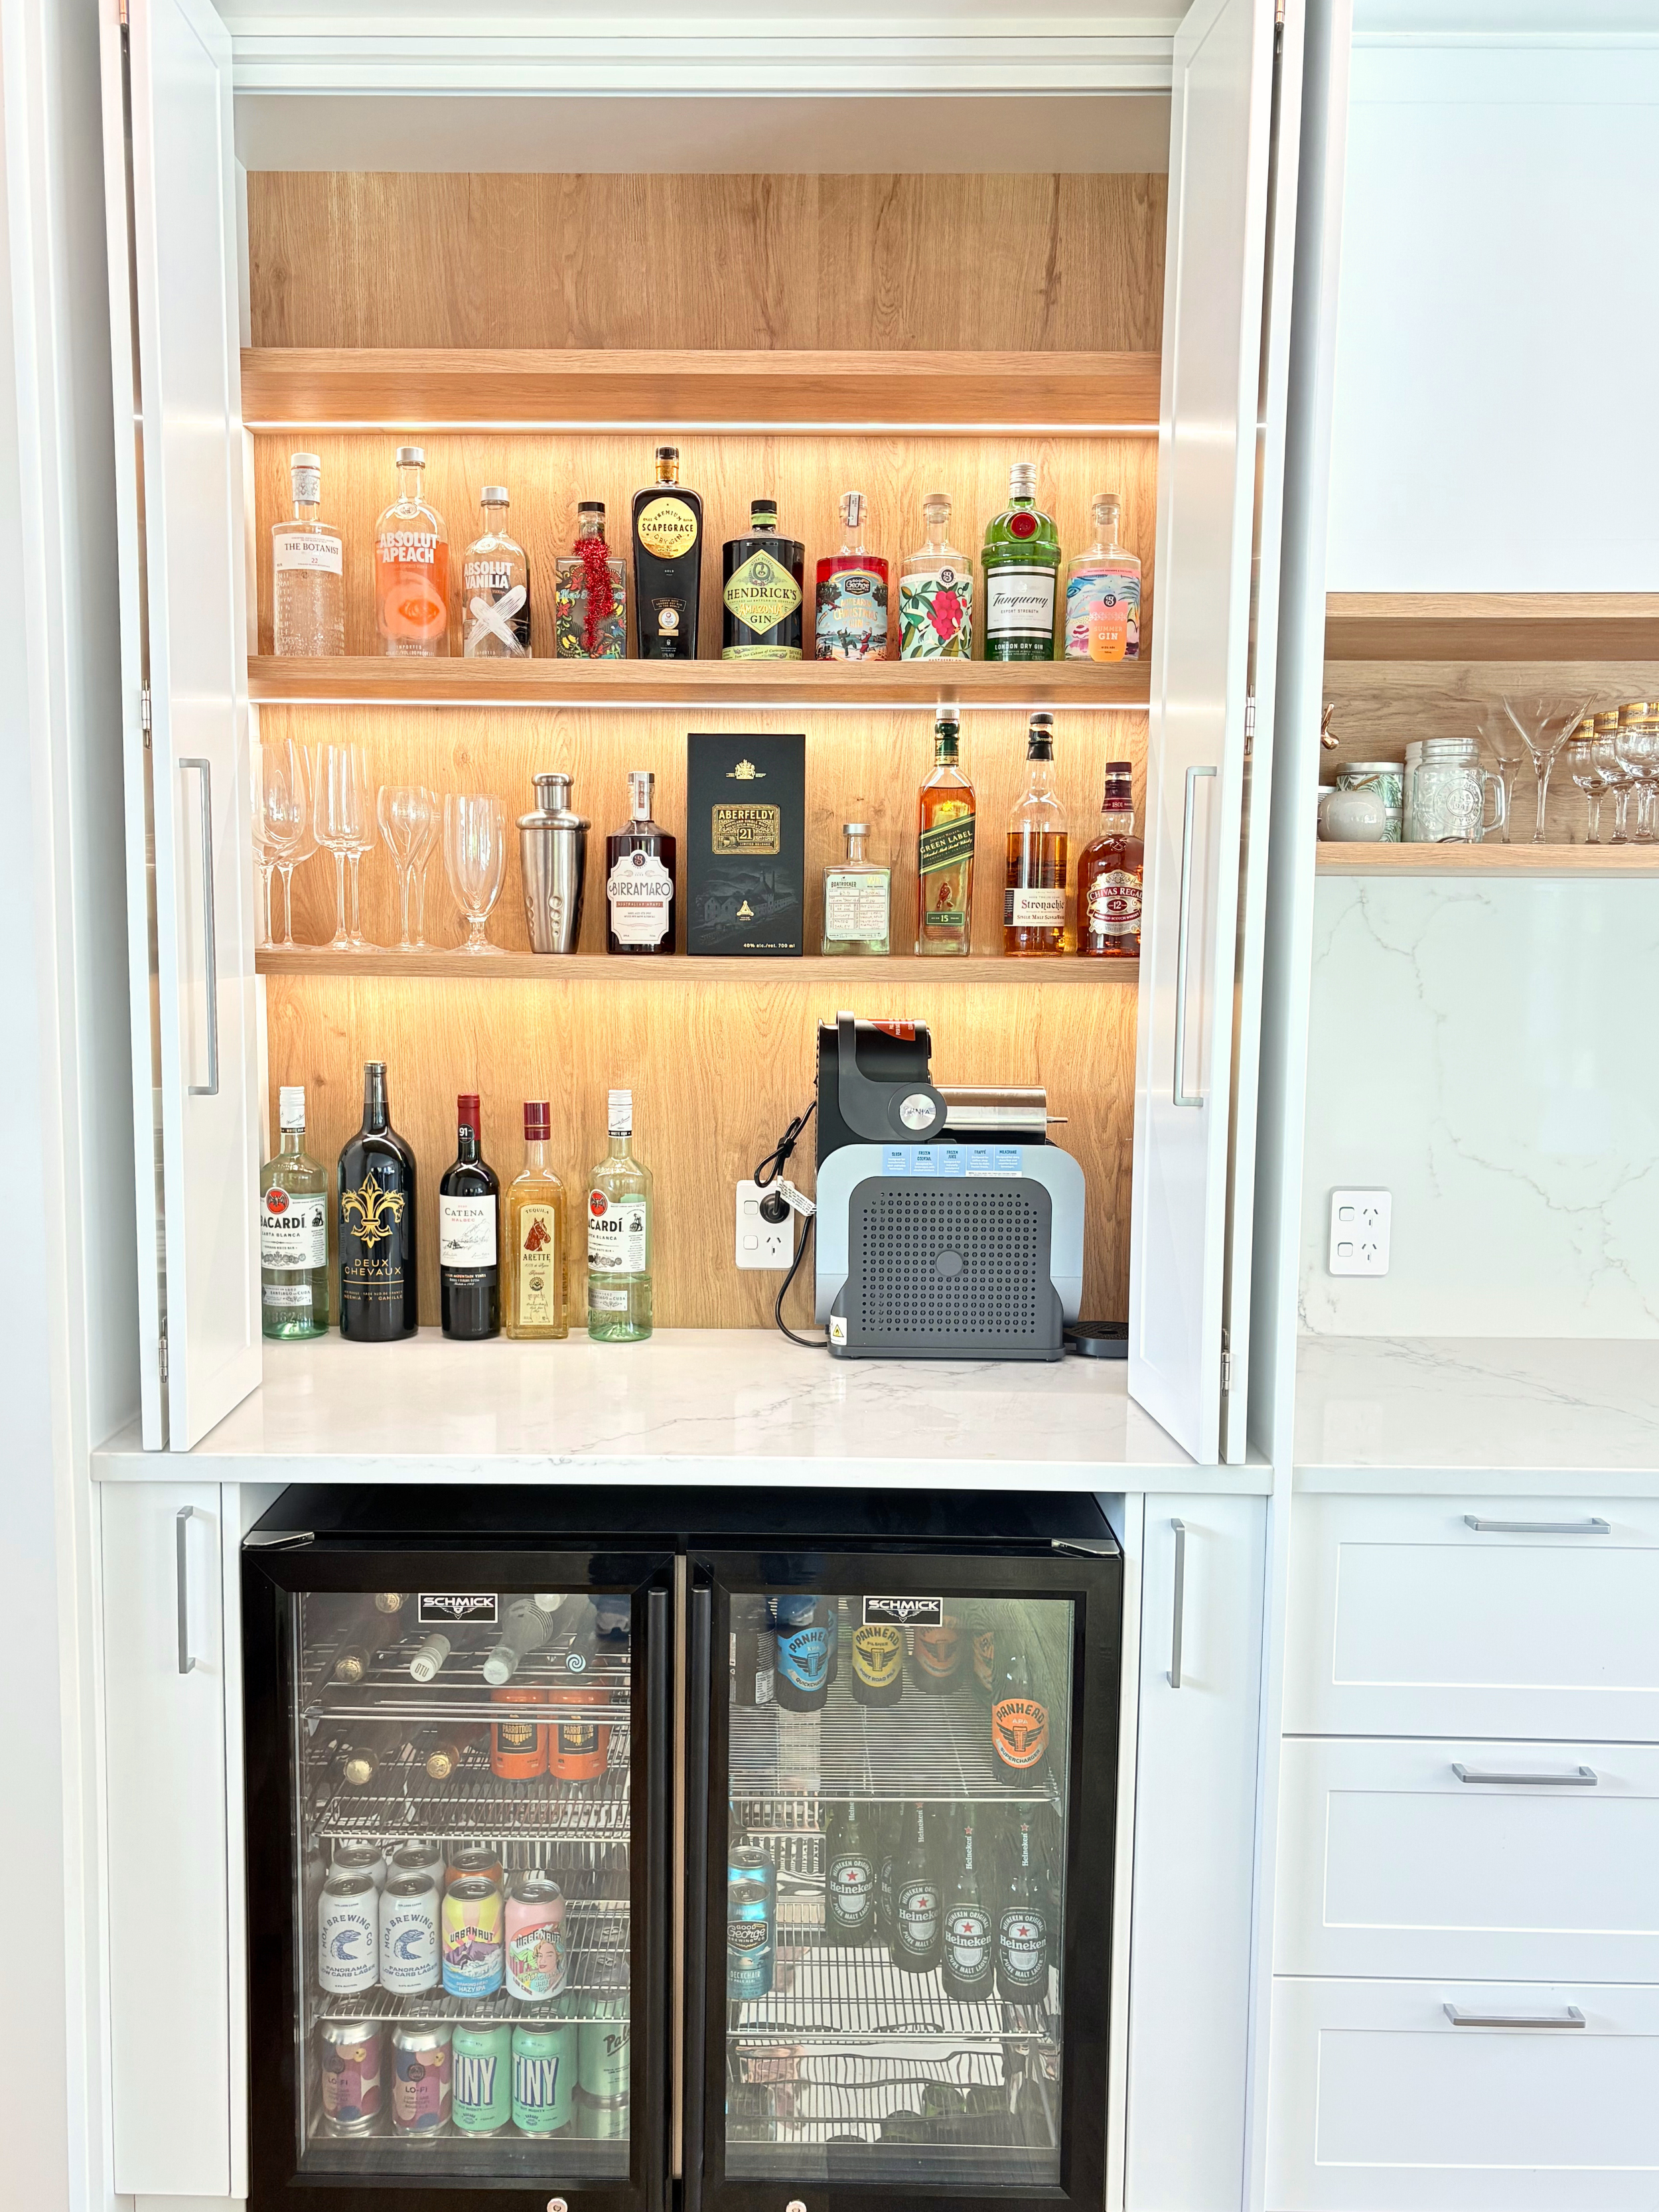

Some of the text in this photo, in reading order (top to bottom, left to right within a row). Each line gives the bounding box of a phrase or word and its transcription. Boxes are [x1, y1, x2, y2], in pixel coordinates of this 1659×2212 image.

[654, 510, 682, 521] PREMIUM
[642, 523, 693, 532] SCAPEGRACE
[380, 530, 438, 549] ABSOLUT
[654, 534, 682, 544] DRY GIN
[303, 543, 338, 555] BOTANIST
[382, 547, 434, 563] APEACH
[464, 561, 512, 577] ABSOLUT
[465, 574, 509, 590] VANILIA
[846, 580, 869, 590] George
[727, 587, 796, 601] HENDRICK'S
[992, 593, 1048, 608] Tanqueray
[738, 603, 784, 617] AMAZONIA
[833, 607, 878, 621] CHRISTMAS
[719, 810, 774, 820] ABERFELDY
[739, 828, 753, 840] 21
[920, 830, 973, 853] GREEN LABEL
[867, 875, 881, 885] Wh
[609, 882, 671, 896] BIRRAMARO
[1090, 887, 1143, 900] CHIVAS REGAL
[1113, 901, 1121, 909] 12
[459, 1127, 468, 1136] 91
[445, 1207, 484, 1217] CATENA
[354, 1258, 389, 1267] DEUX
[344, 1266, 401, 1276] CHEVAUX
[423, 1597, 494, 1606] SCHMICK
[868, 1599, 939, 1609] SCHMICK
[855, 1627, 900, 1646] PANHEAD
[414, 1662, 430, 1678] OTU
[859, 1668, 870, 1680] PORT
[996, 1702, 1045, 1725] PANHEAD
[502, 1724, 532, 1733] PARROTDOG
[564, 1726, 594, 1734] PARROTDOG
[1000, 1747, 1041, 1763] SUPERCHARGER
[833, 1860, 871, 1877] HEINEKEN ORIGINAL
[830, 1880, 873, 1894] Heineken
[901, 1886, 923, 1904] HEINEKEN
[833, 1903, 844, 1917] PURE
[859, 1901, 871, 1917] LAGER
[948, 1911, 989, 1929] HEINEKEN ORIGINAL
[1002, 1915, 1045, 1932] HEINEKEN ORIGINAL
[326, 1914, 371, 1931] BREWING
[366, 1931, 373, 1946] CO
[390, 1914, 433, 1929] BREWING
[429, 1931, 435, 1945] CO
[450, 1926, 494, 1943] URBANAUT
[727, 1925, 766, 1940] George
[516, 1929, 561, 1949] URBANAUT
[902, 1931, 929, 1947] PURE MALT
[945, 1930, 991, 1947] Heineken
[1000, 1934, 1046, 1951] Heineken
[326, 1964, 368, 1972] PANORAMA
[354, 1963, 376, 1976] LAGER
[389, 1963, 431, 1972] PANORAMA
[417, 1962, 438, 1976] LAGER
[948, 1954, 958, 1970] PURE
[975, 1955, 988, 1972] LAGER
[1003, 1958, 1044, 1978] PURE MALT LAGER
[730, 1970, 760, 1980] DECKCHAIR
[452, 2050, 498, 2107] TINY
[512, 2050, 559, 2108] TINY
